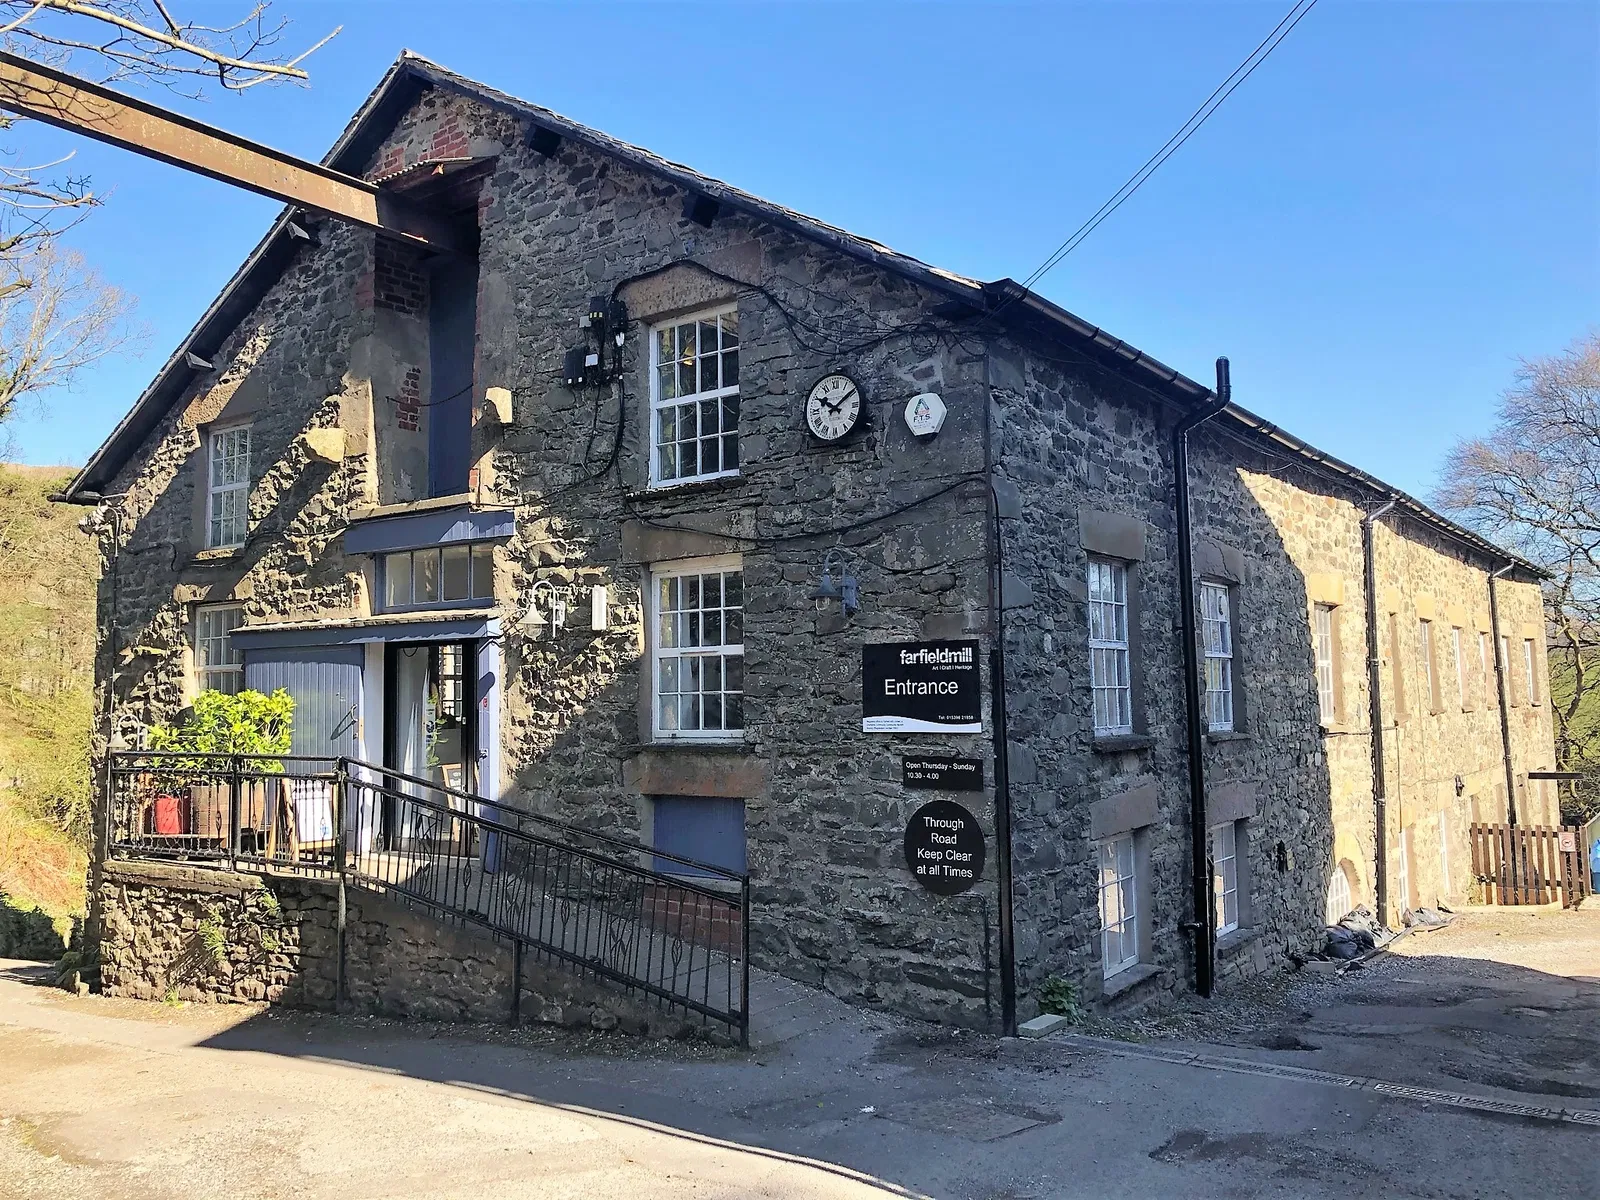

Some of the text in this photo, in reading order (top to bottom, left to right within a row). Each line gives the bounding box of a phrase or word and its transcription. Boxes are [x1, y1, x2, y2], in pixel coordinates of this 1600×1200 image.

[899, 647, 973, 665] farfieldmill
[884, 678, 959, 695] Entrance
[905, 761, 921, 770] Open
[921, 761, 949, 771] Thursday
[952, 762, 976, 772] Sunday
[907, 771, 922, 779] 10.30
[926, 772, 940, 780] 4.00
[922, 816, 964, 831] Through
[931, 832, 957, 844] Road
[917, 847, 973, 862] Keep Clear
[916, 864, 973, 878] at all Times
